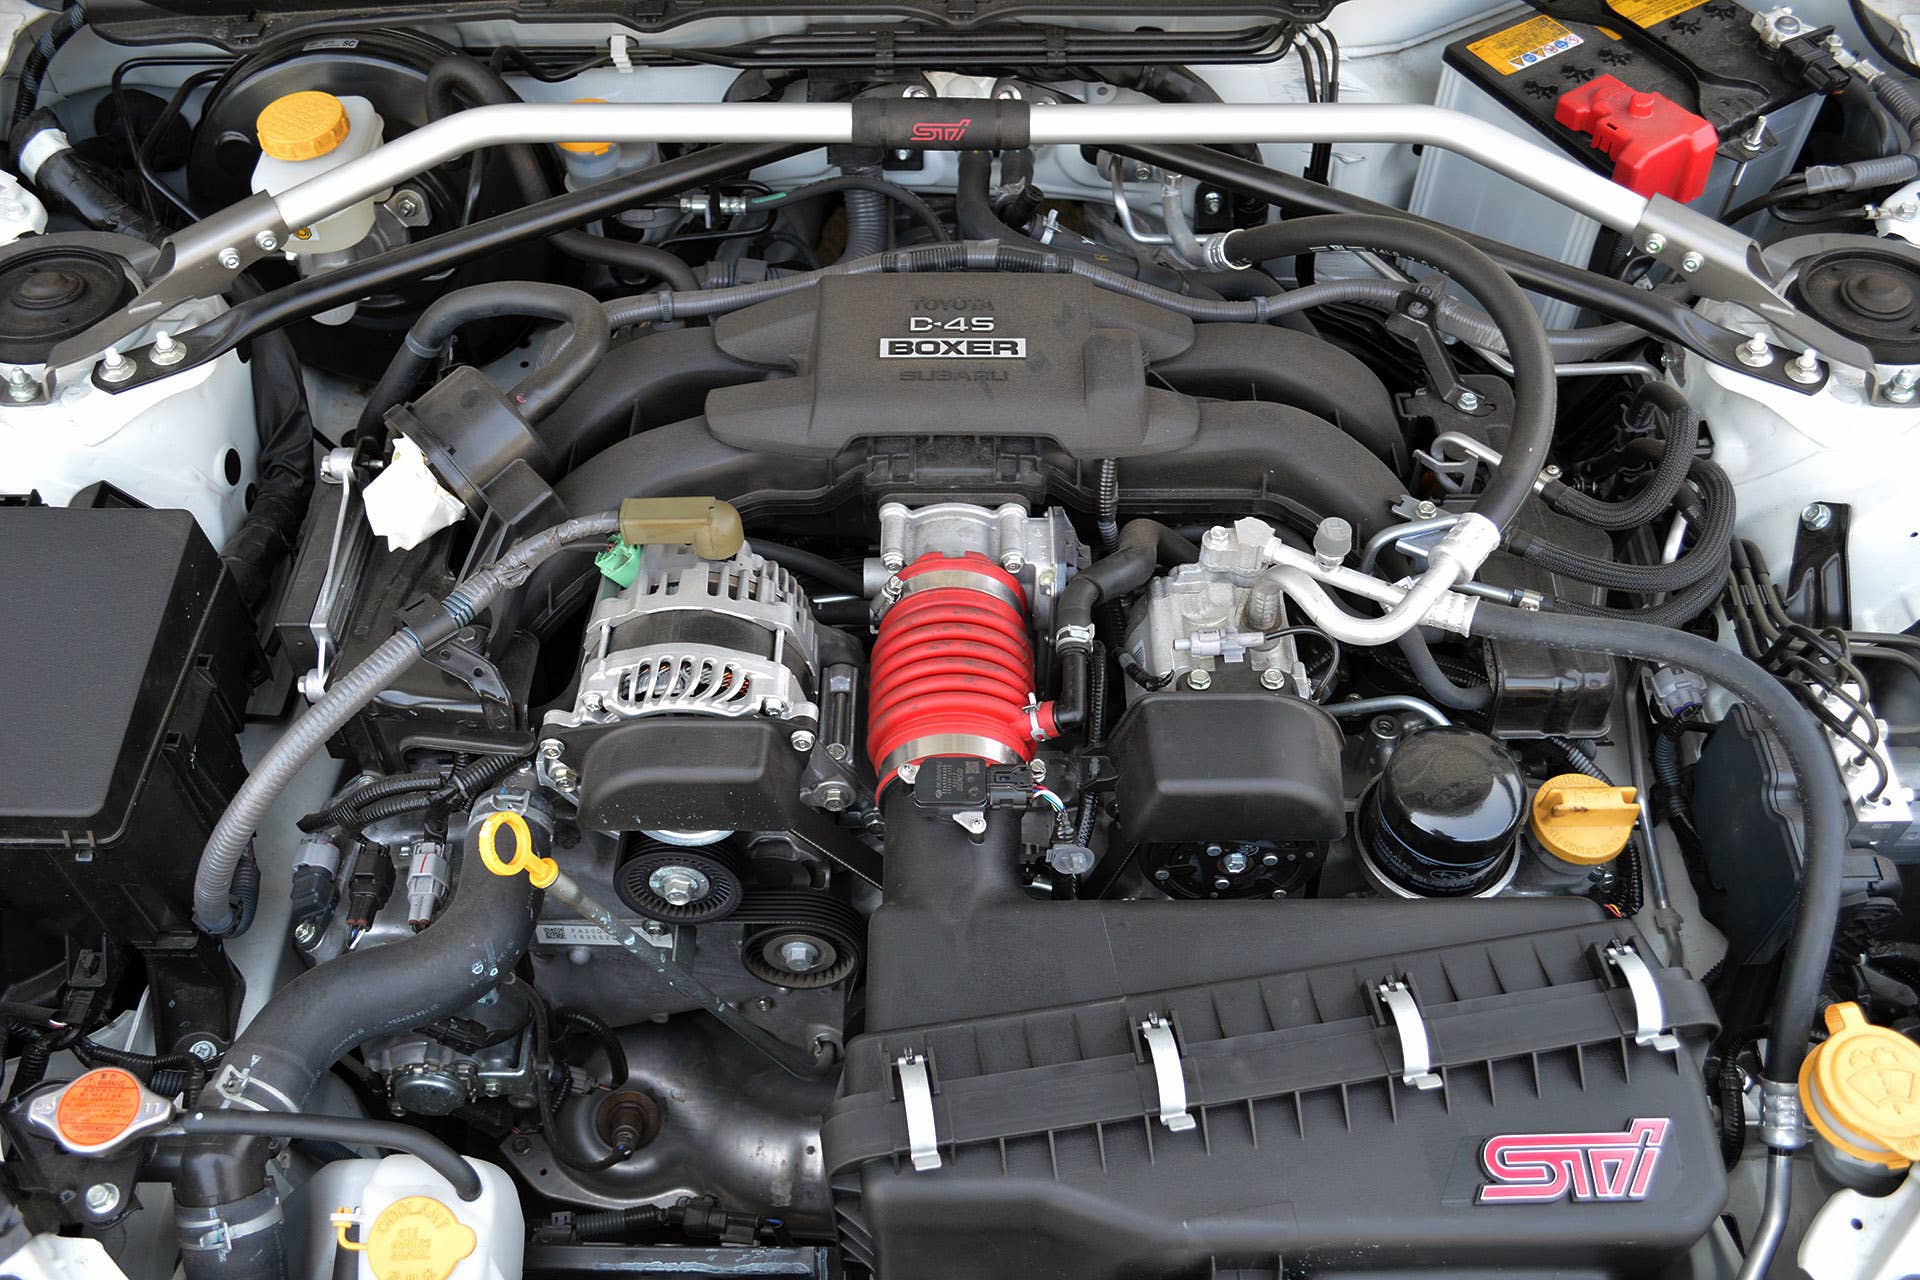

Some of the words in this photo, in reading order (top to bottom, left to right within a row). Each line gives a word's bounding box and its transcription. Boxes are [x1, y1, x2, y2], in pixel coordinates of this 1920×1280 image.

[911, 298, 995, 312] TOYOTA
[887, 340, 1019, 356] BOXER
[900, 369, 1008, 382] SUBARU
[377, 1201, 452, 1233] COOLANT
